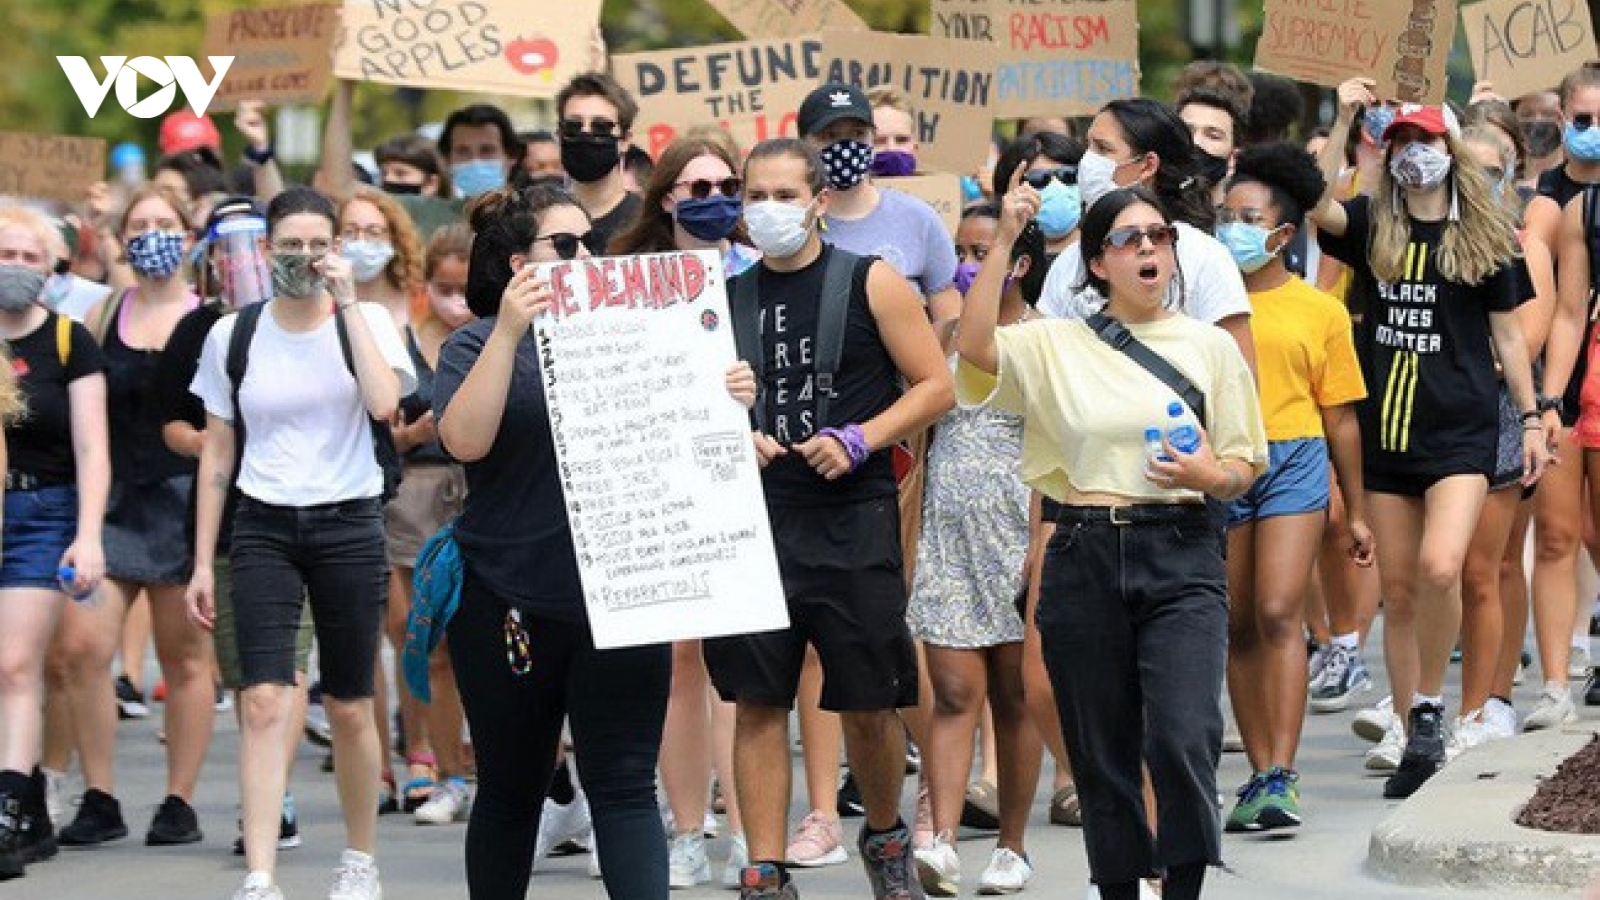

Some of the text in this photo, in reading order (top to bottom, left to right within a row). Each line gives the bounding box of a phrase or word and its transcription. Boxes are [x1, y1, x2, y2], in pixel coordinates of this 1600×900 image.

[356, 1, 489, 54] GOOD
[360, 23, 502, 79] APPLES
[1008, 11, 1111, 50] RACISM
[1267, 10, 1389, 69] SUPREMACY
[1481, 0, 1586, 80] ACAB
[636, 40, 822, 97] DEFUND
[704, 89, 763, 118] THE
[1387, 306, 1433, 327] IVES
